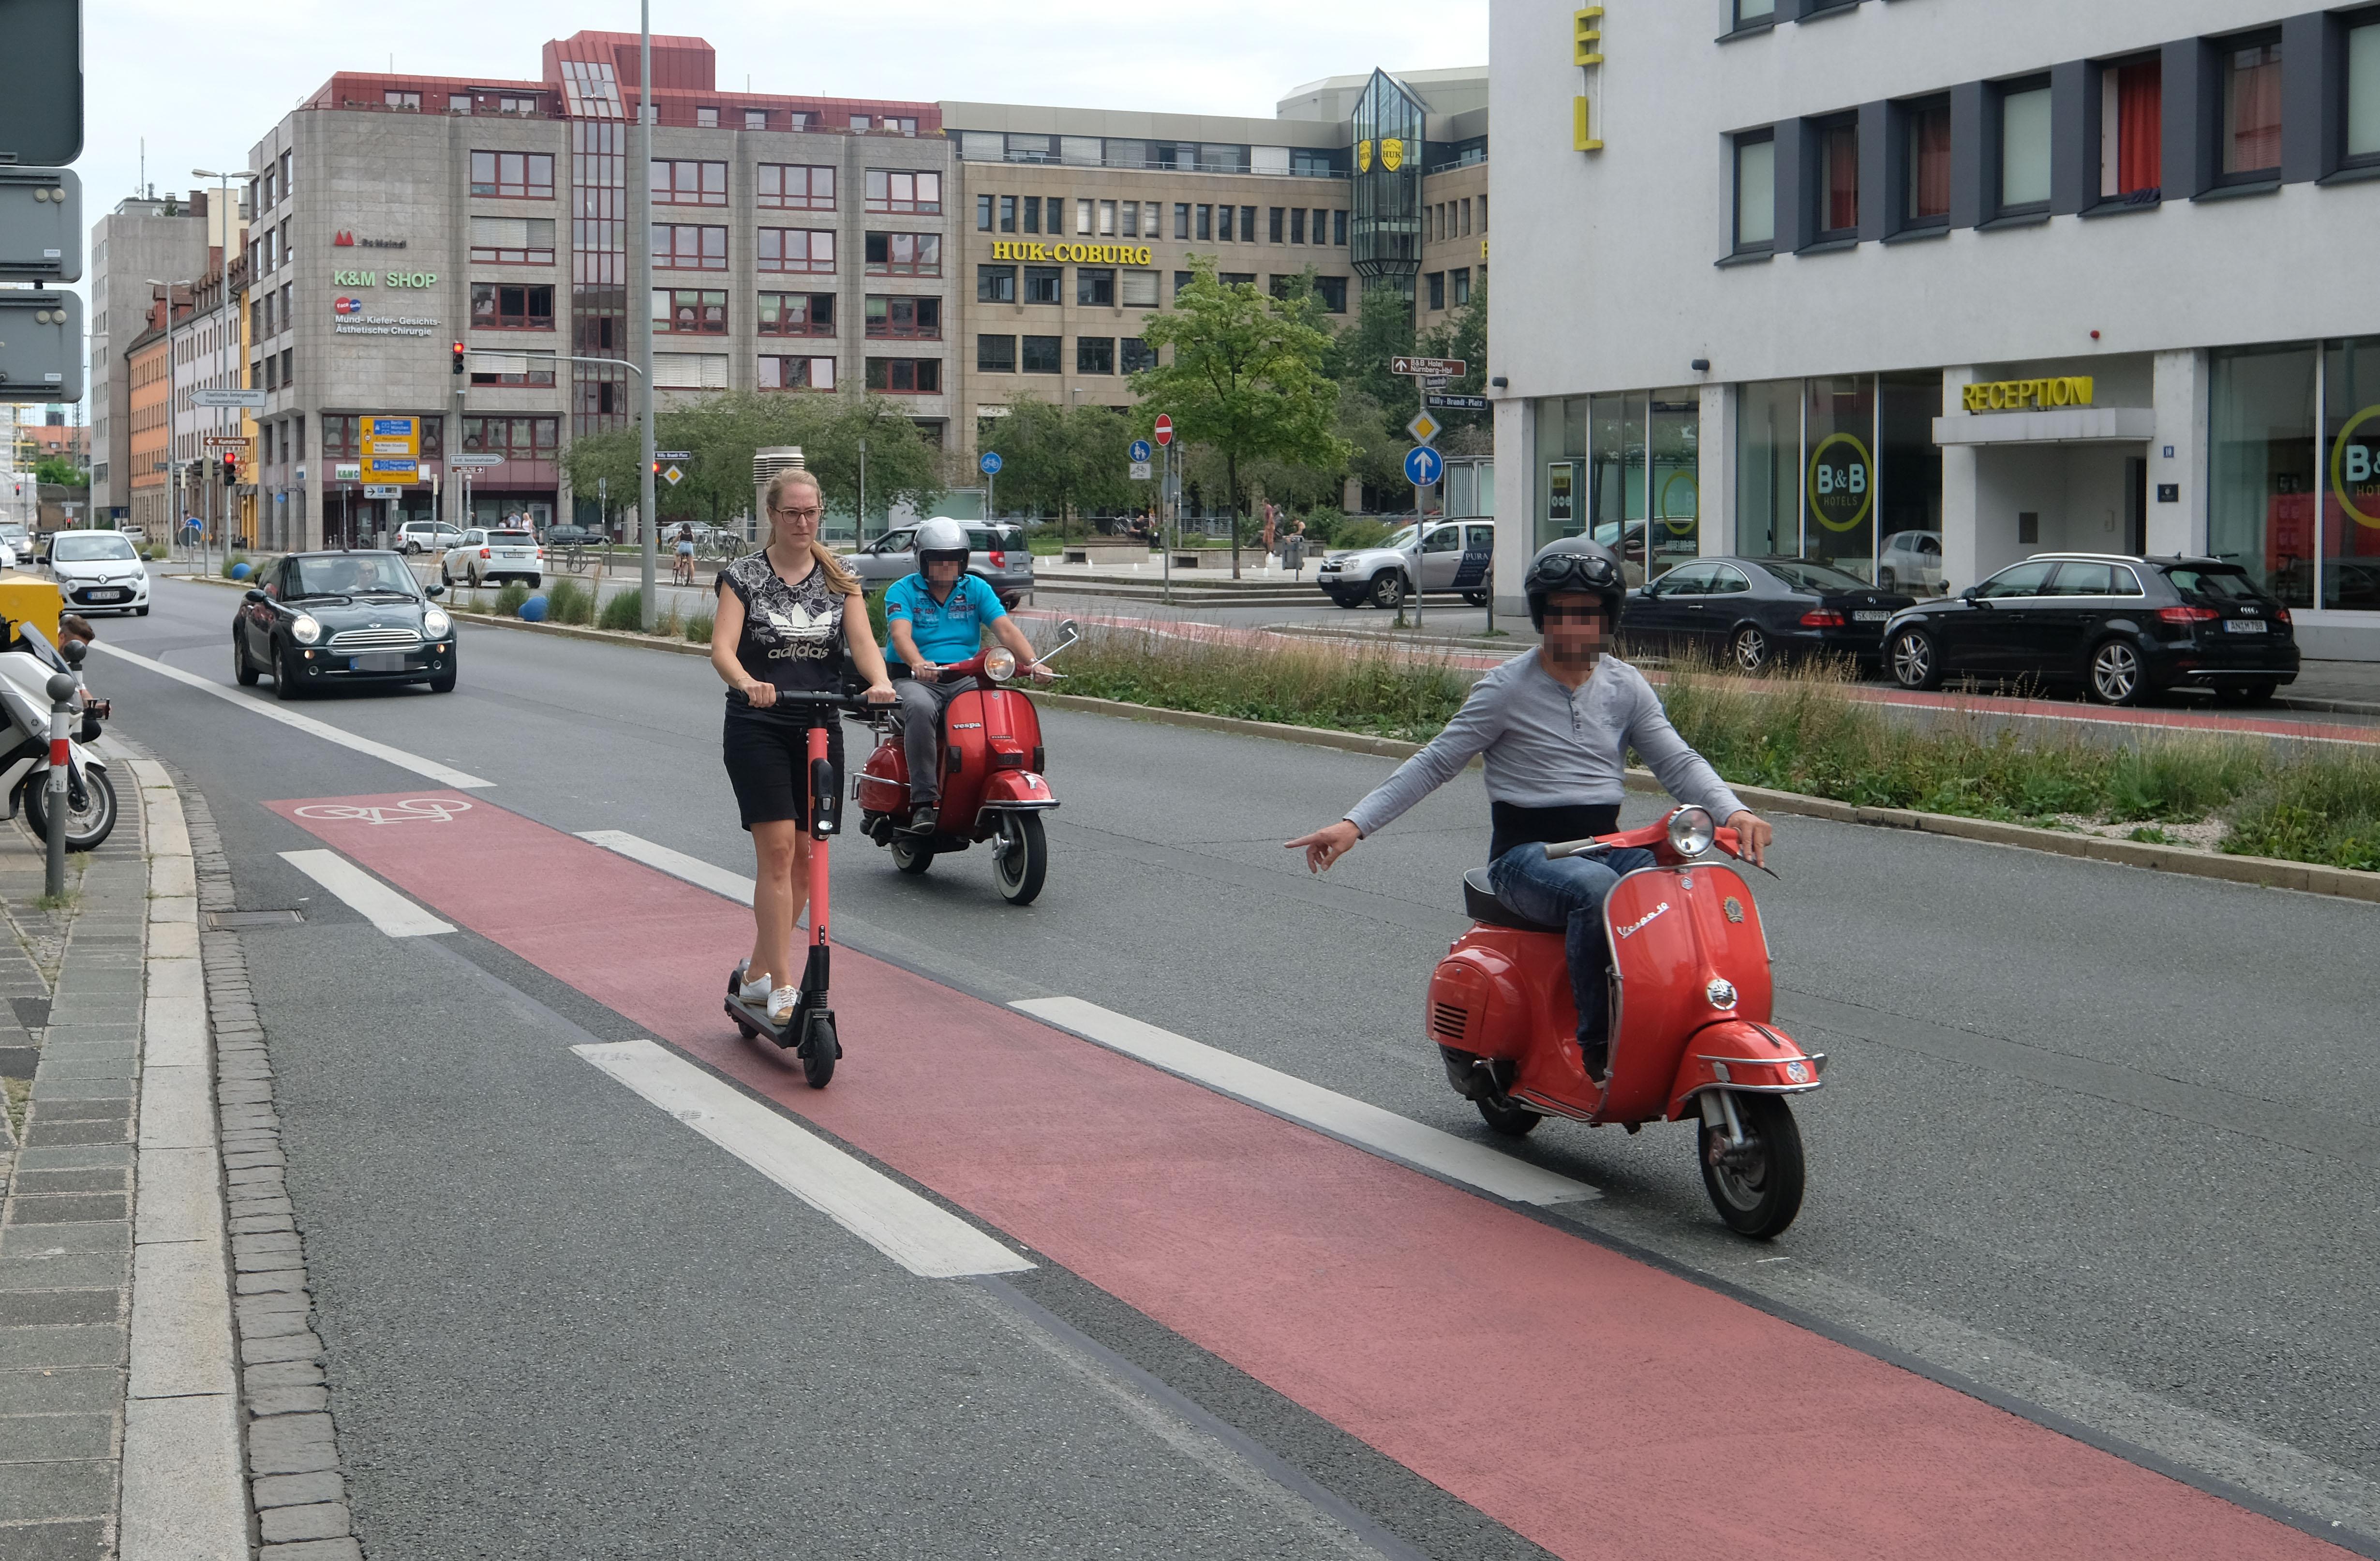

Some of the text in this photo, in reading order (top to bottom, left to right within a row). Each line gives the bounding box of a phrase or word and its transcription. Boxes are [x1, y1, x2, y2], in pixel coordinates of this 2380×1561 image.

[1360, 152, 1370, 160] HUK
[992, 241, 1152, 265] HUK-COBURG
[334, 270, 437, 288] K&M SHOP
[335, 315, 441, 326] Mund- Kiefer- Gesichts-
[335, 324, 432, 336] Ästhetische Chirurgie
[1411, 366, 1453, 374] Nürnberg-Hbf
[1963, 376, 2093, 410] RECEPTION
[2165, 446, 2172, 457] 10
[1817, 463, 1866, 494] B&B
[1824, 496, 1858, 506] HOTELS
[768, 643, 829, 659] adidas
